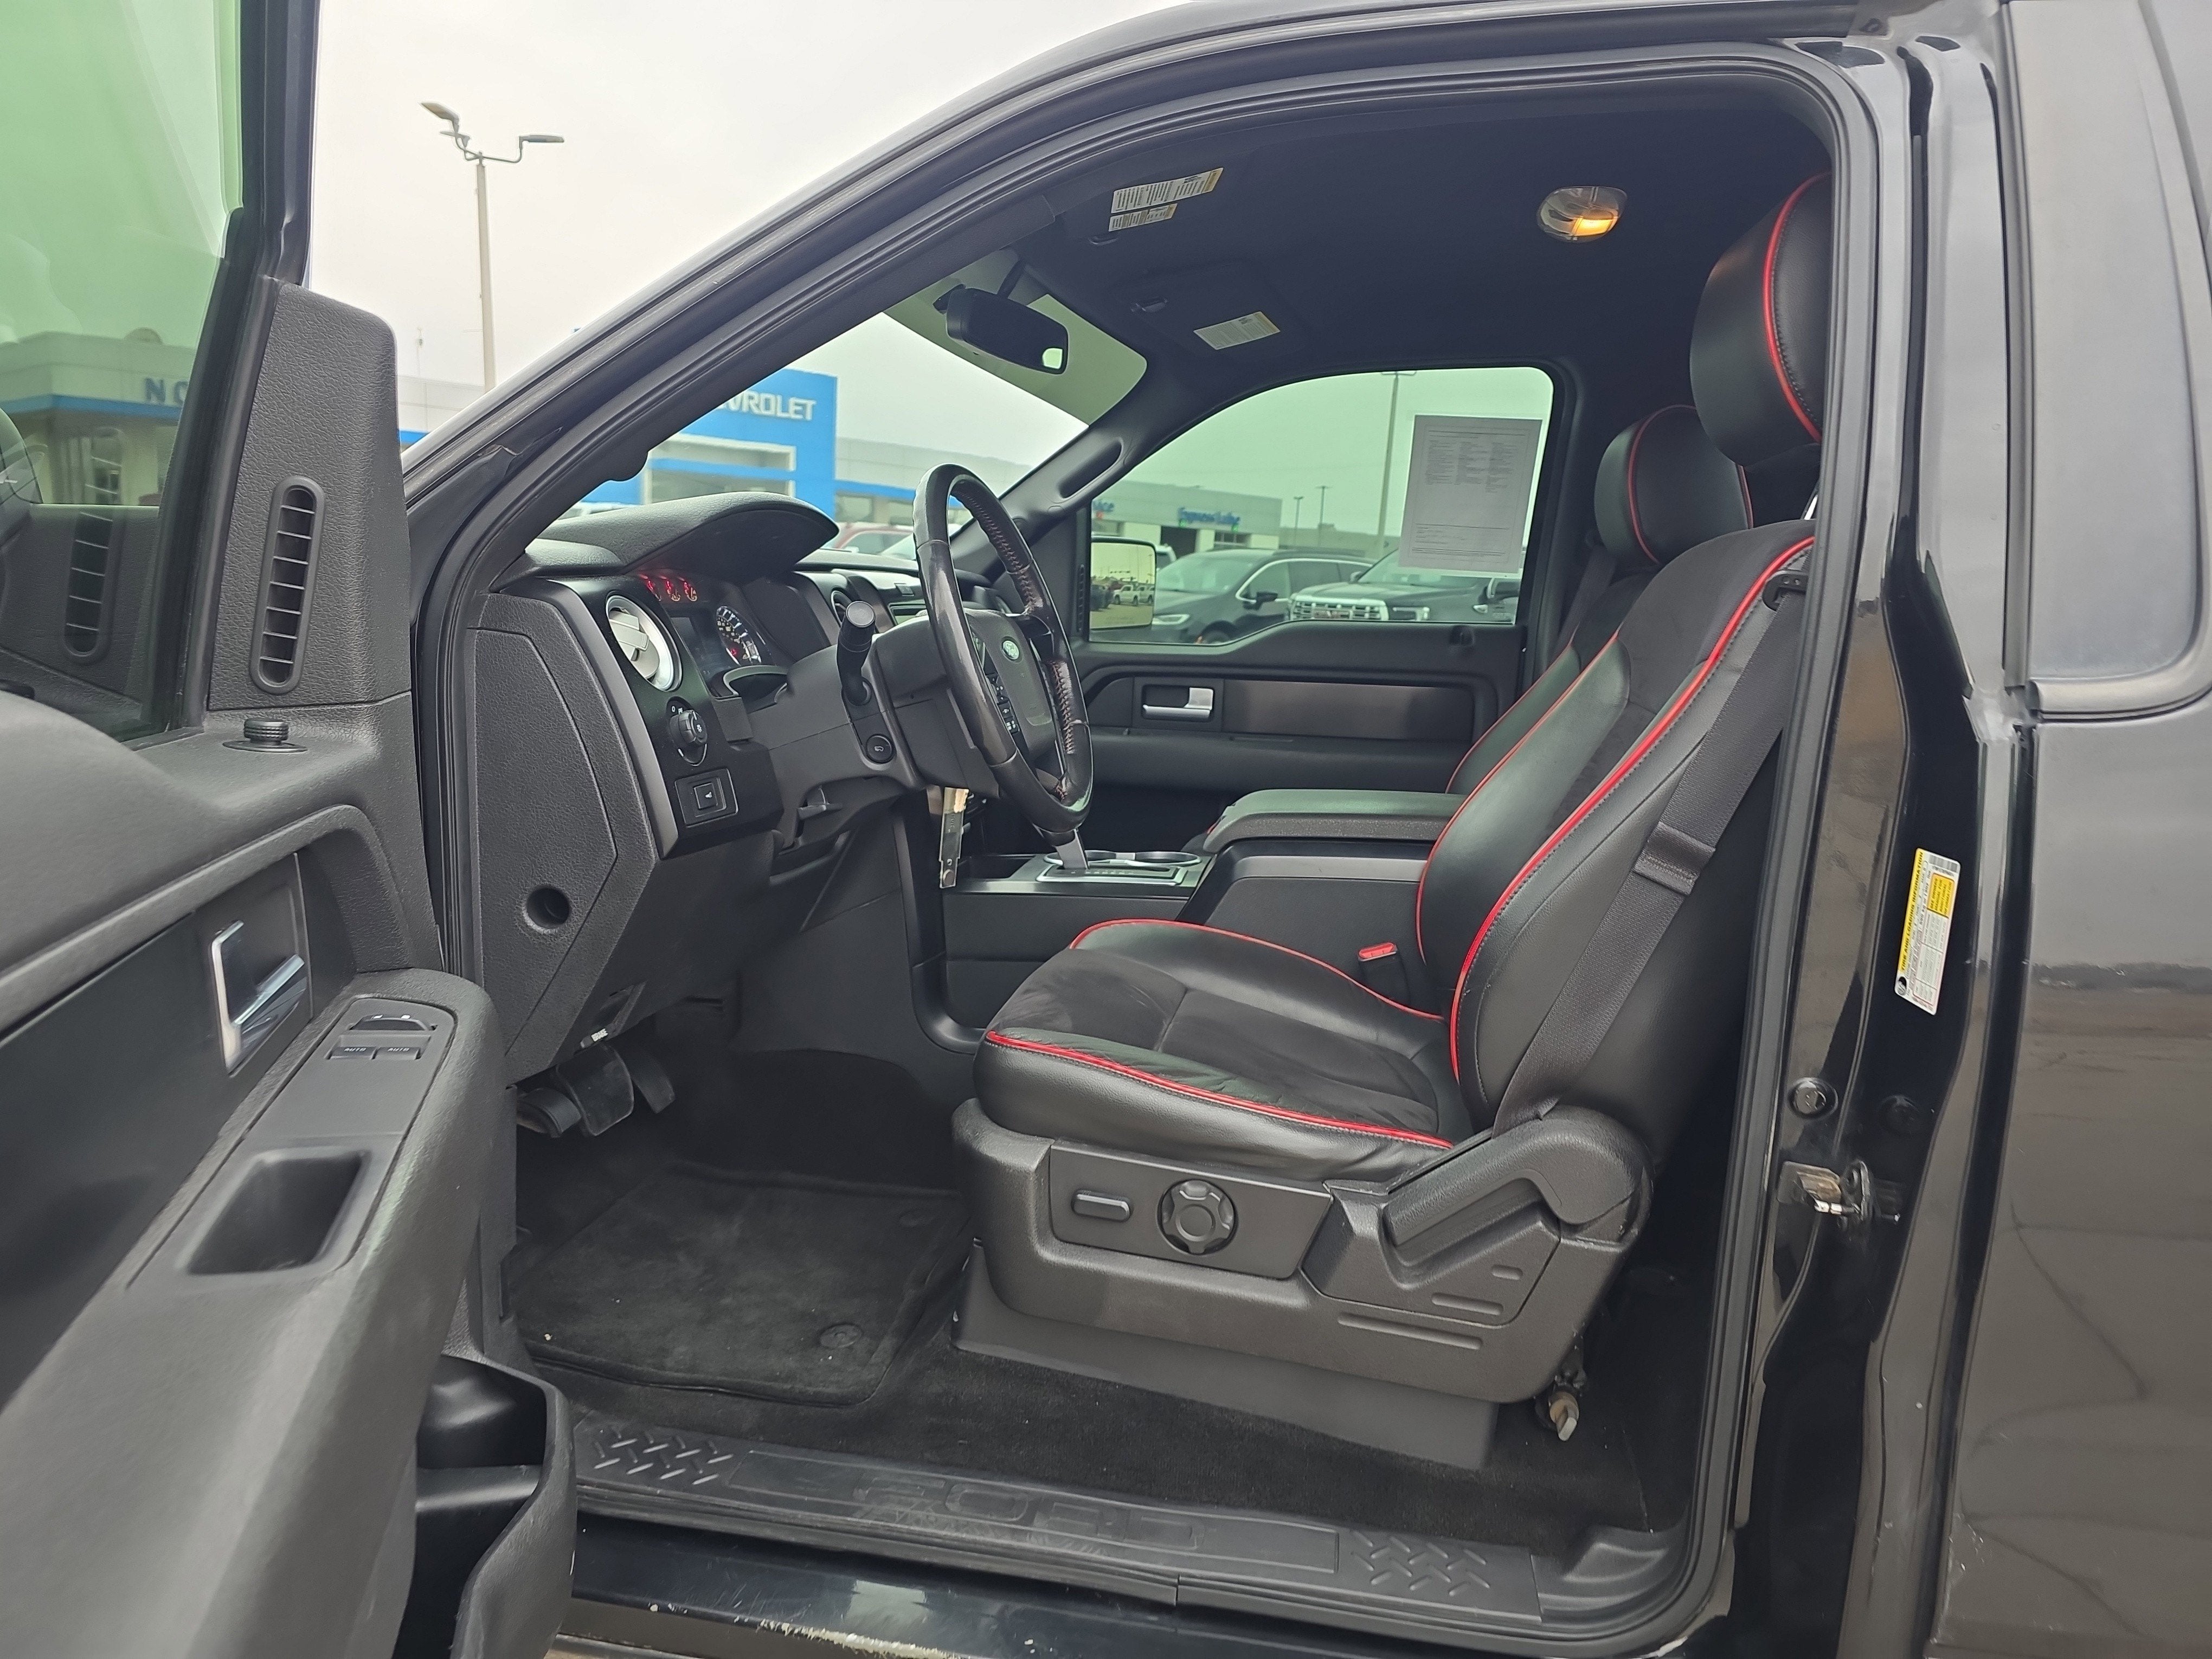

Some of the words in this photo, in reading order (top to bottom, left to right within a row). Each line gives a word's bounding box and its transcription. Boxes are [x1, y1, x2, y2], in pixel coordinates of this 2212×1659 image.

[717, 390, 816, 421] VROLET
[1907, 904, 1915, 936] LOADING
[1912, 851, 1923, 903] INFORMATION
[853, 1475, 1206, 1551] FORD
